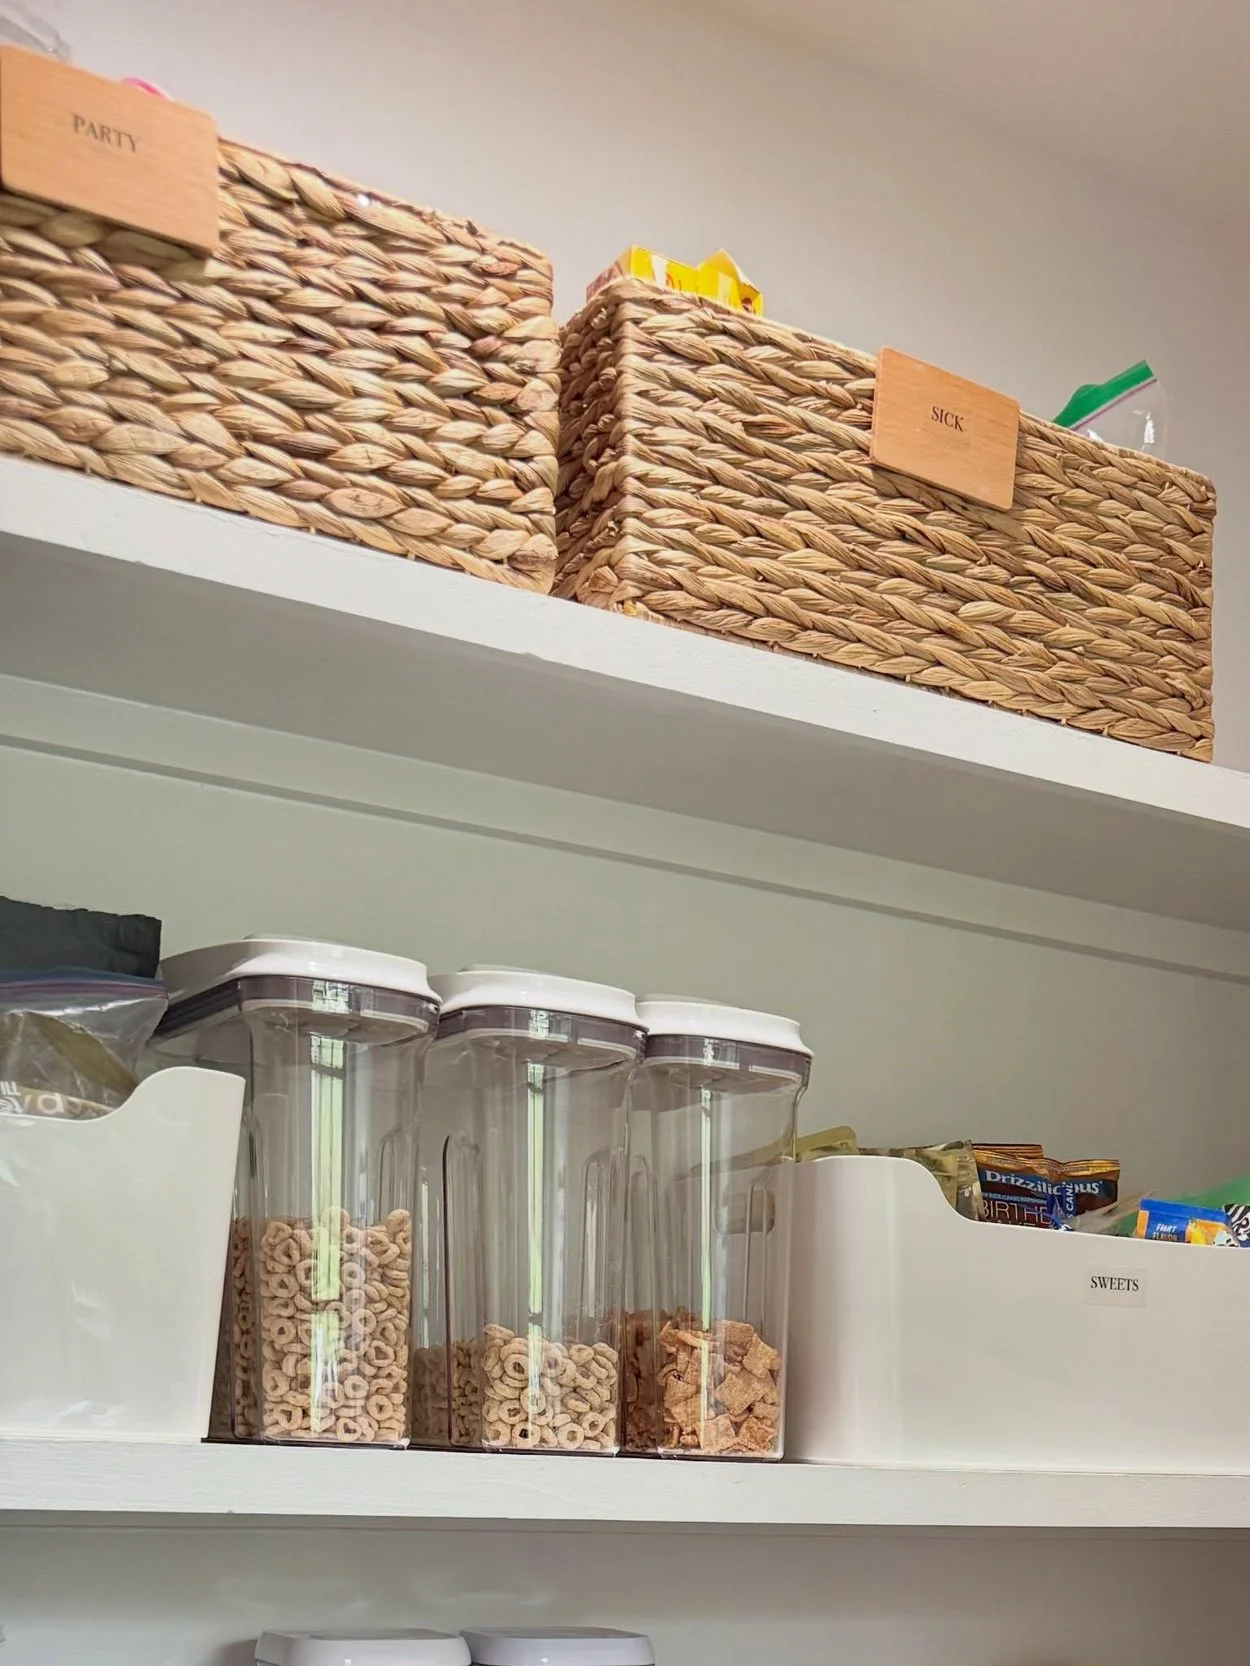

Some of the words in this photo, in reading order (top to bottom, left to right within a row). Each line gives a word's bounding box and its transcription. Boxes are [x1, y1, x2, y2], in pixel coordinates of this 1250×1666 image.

[72, 112, 138, 153] PARTY
[931, 405, 964, 432] SICK
[1156, 1223, 1178, 1233] FRUIT
[1090, 1276, 1140, 1292] SWEETS
